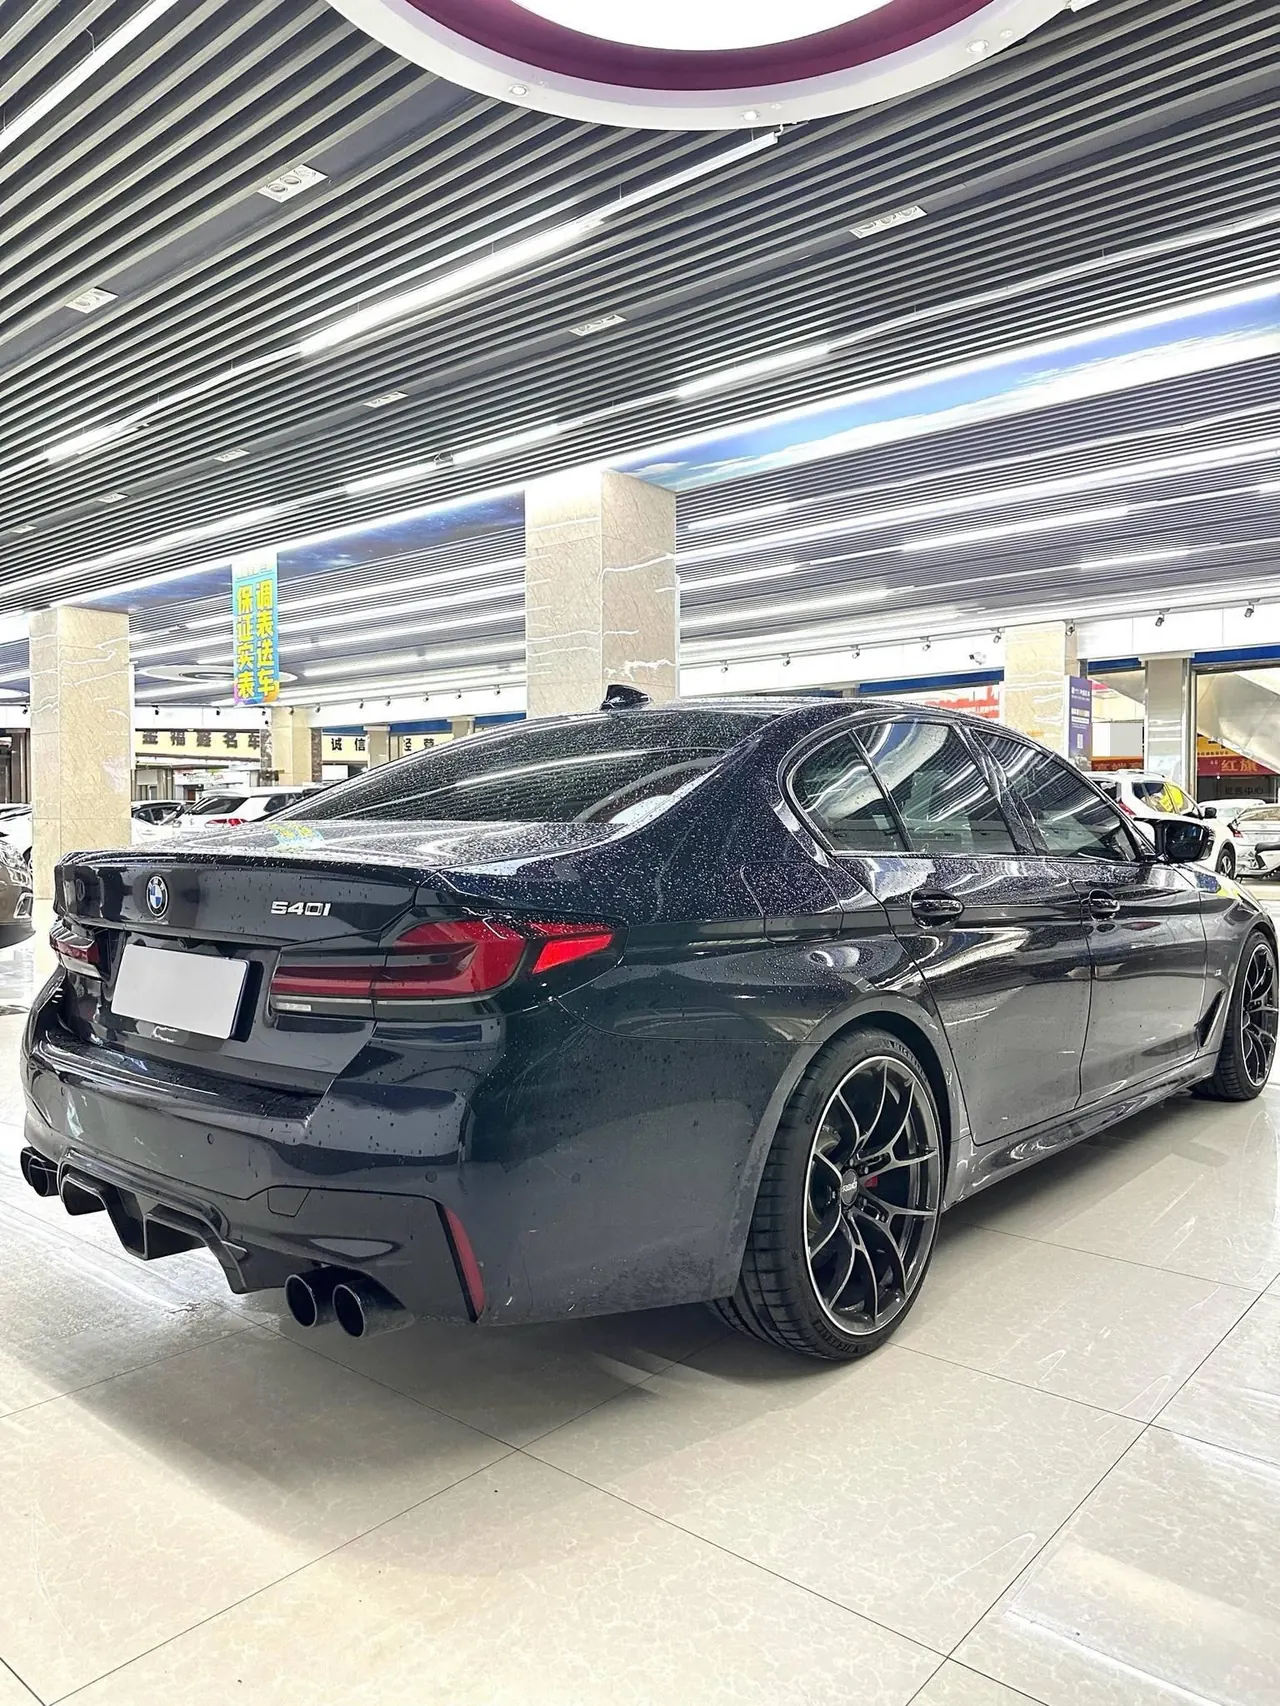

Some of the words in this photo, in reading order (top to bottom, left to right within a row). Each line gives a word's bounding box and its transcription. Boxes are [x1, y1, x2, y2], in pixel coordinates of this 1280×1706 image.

[237, 584, 254, 698] 保证实表
[255, 578, 275, 696] 调表送车
[331, 737, 366, 751] 诚信
